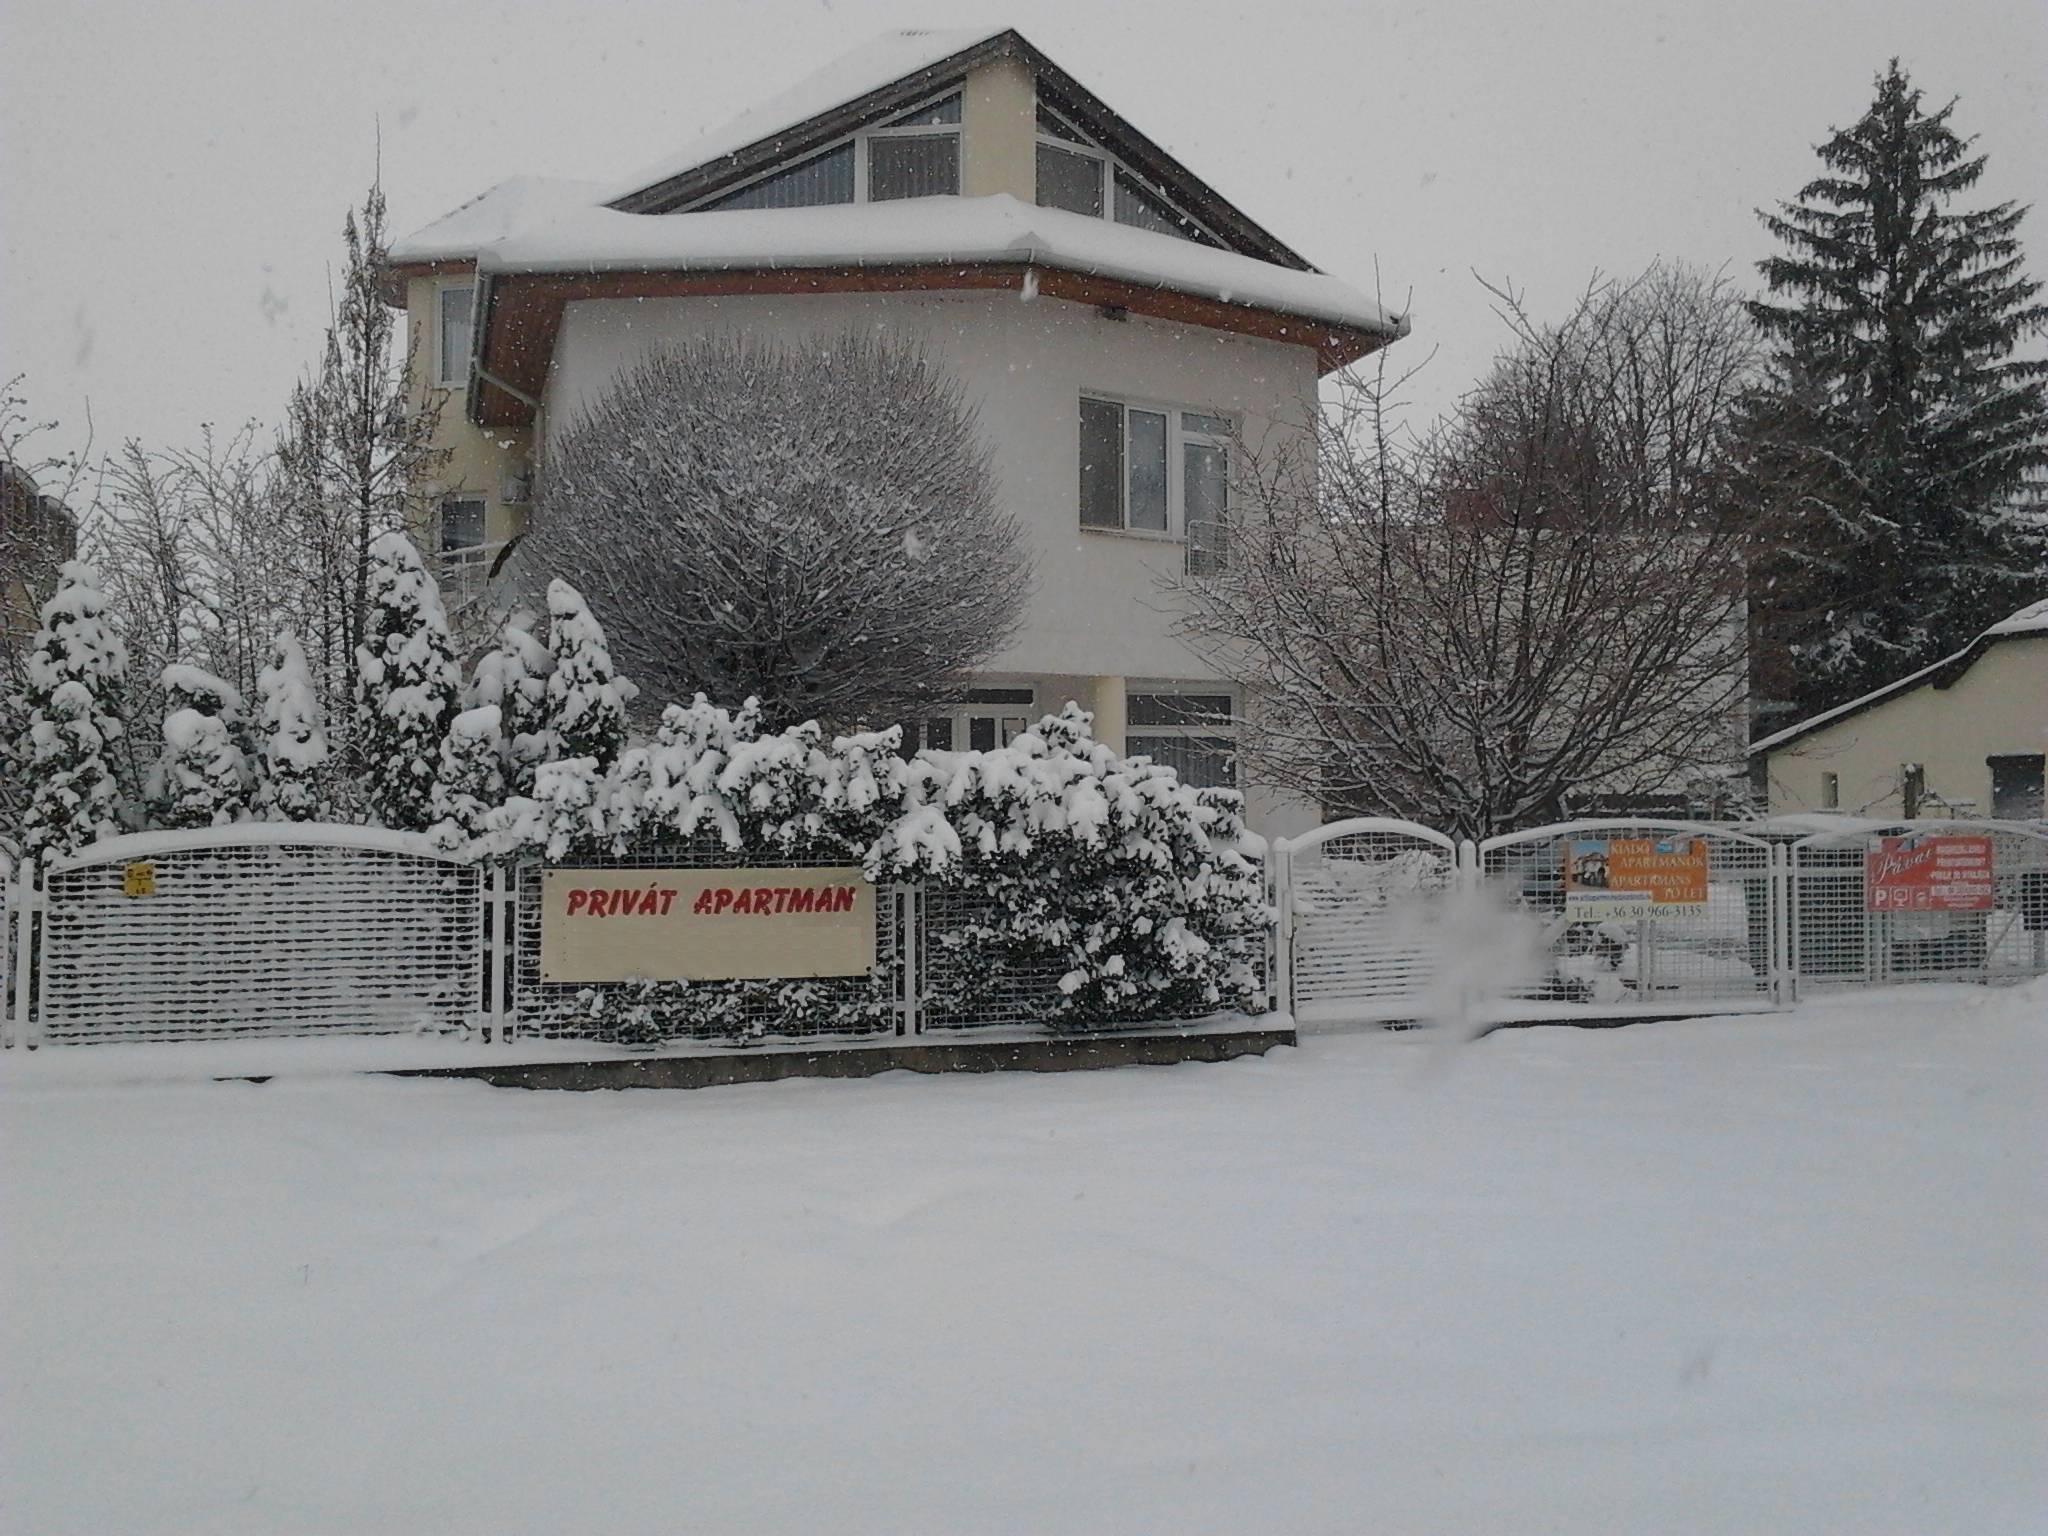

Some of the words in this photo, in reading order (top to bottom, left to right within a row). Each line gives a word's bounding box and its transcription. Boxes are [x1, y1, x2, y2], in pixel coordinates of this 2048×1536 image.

[566, 882, 678, 918] PRIVÁT
[693, 886, 857, 917] APARTMAN
[1605, 905, 1627, 918] +36
[1630, 905, 1645, 918] 30
